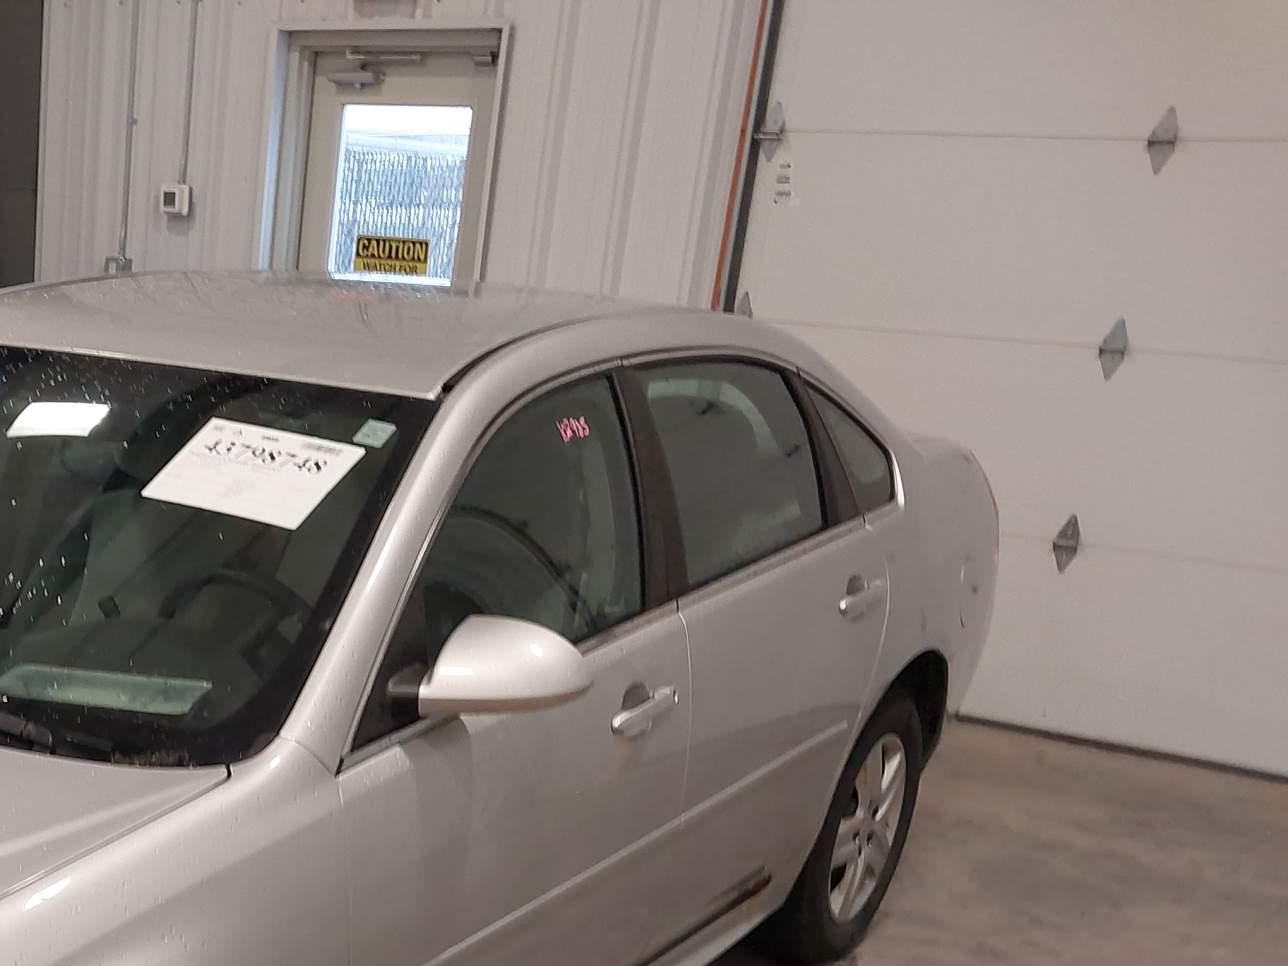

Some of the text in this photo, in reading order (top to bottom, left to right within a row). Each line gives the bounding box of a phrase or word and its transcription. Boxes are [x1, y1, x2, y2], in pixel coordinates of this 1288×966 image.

[358, 238, 427, 262] CAUTION
[362, 260, 419, 274] WATCH FOR
[205, 440, 328, 474] 43798748
